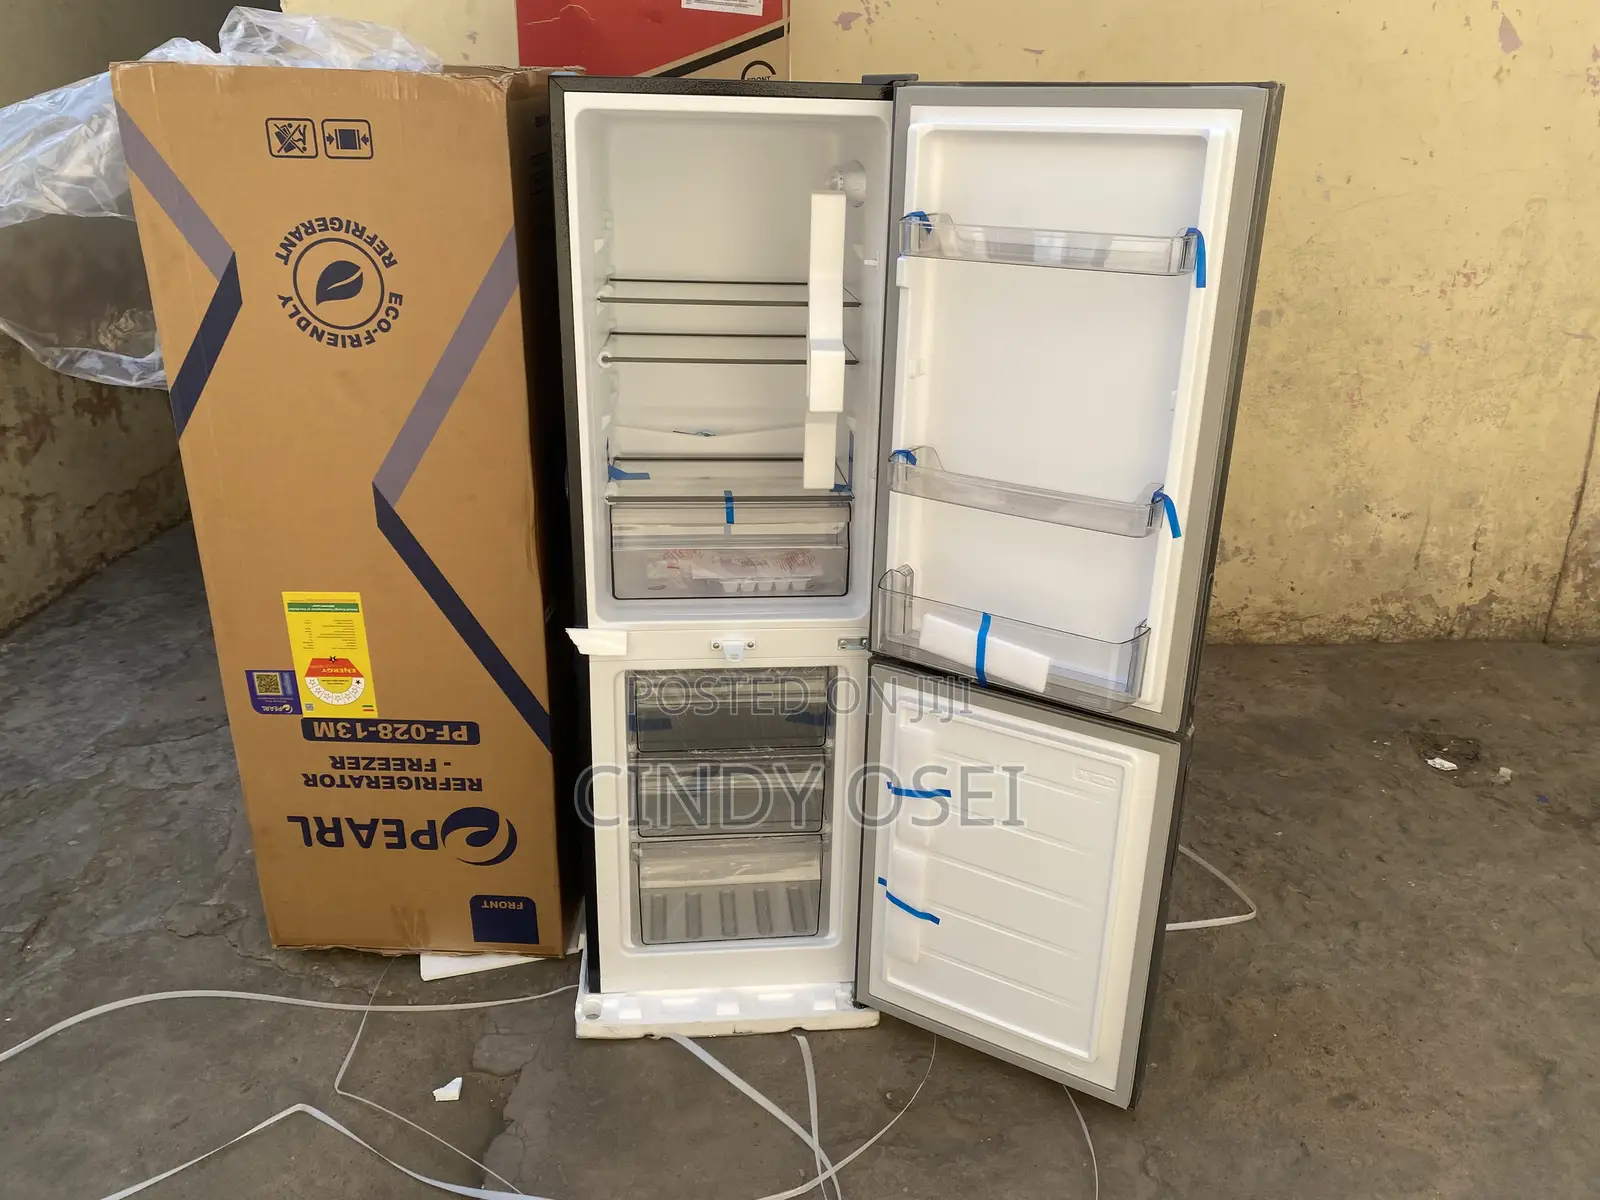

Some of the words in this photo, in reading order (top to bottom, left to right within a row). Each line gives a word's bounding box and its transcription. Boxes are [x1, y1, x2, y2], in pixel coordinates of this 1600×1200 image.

[275, 216, 398, 269] REFRIGERANT
[277, 291, 404, 349] ECO-FRIENDLY
[313, 721, 469, 742] PF-028-13M
[329, 756, 437, 772] FREEZER
[301, 773, 483, 792] REFRIGERATOR
[286, 816, 439, 850] PEARL
[482, 900, 524, 910] FRONT
